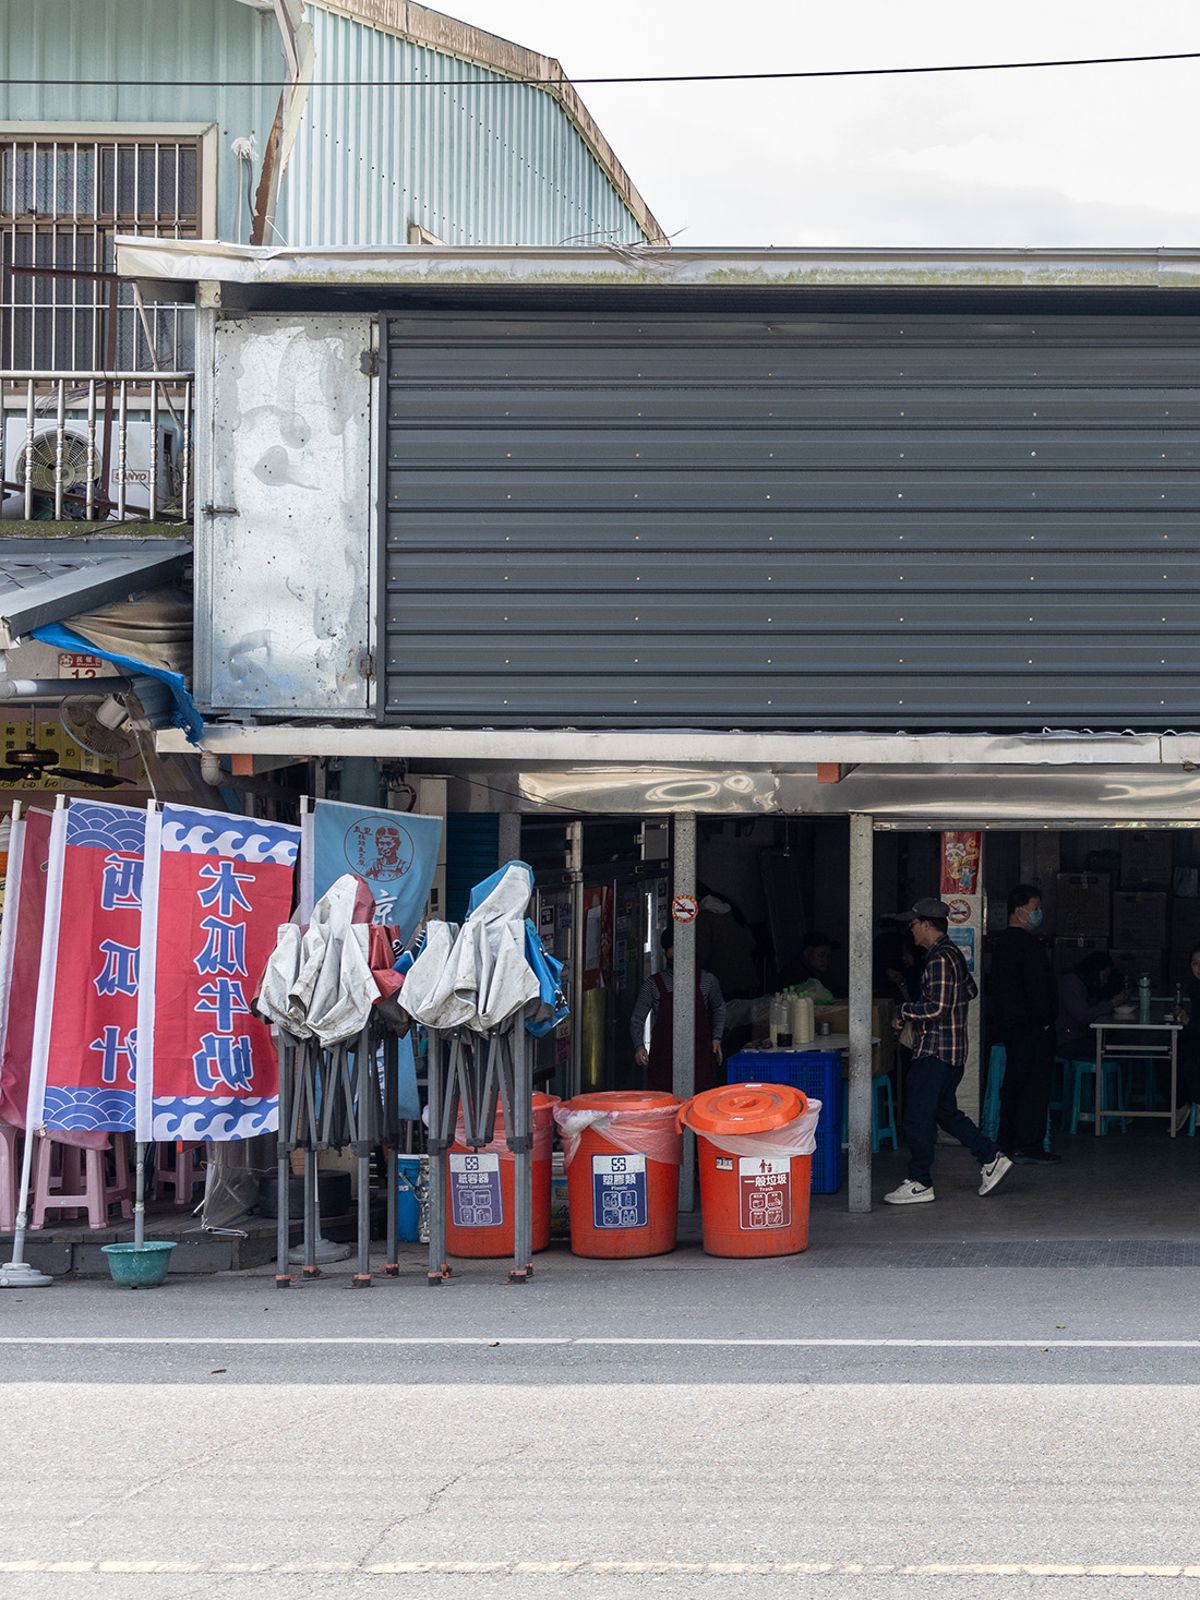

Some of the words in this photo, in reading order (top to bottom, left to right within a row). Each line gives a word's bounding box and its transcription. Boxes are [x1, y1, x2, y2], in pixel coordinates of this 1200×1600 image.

[115, 473, 147, 481] SNYO
[602, 1173, 636, 1186] 塑膠類
[744, 1173, 787, 1187] 一般垃圾
